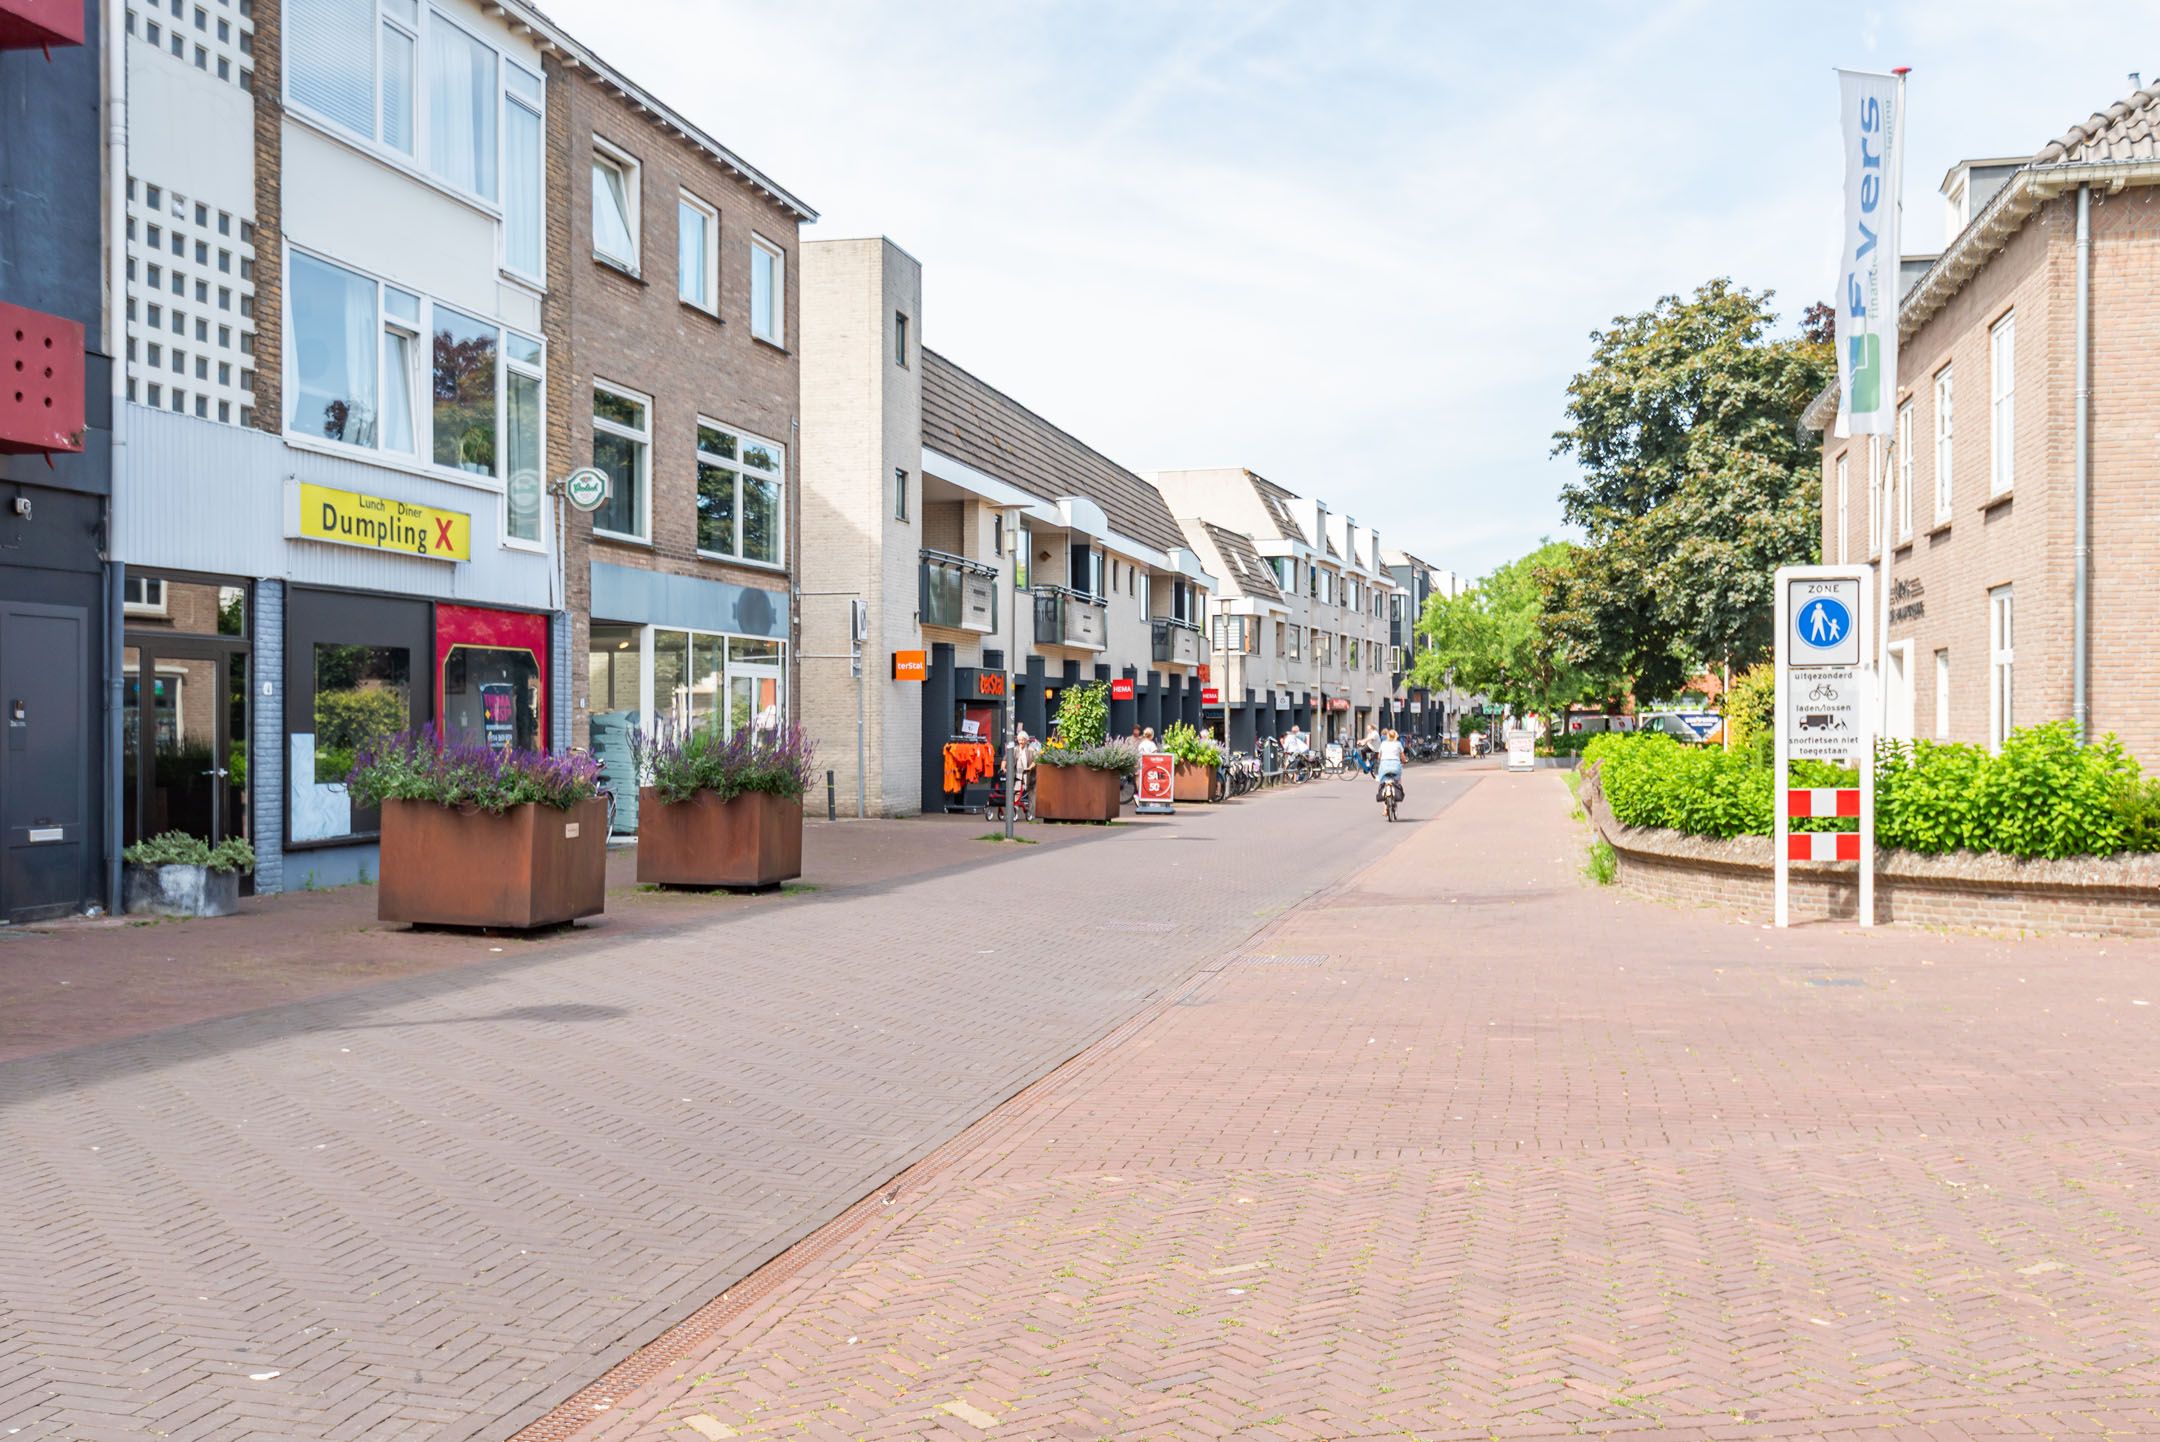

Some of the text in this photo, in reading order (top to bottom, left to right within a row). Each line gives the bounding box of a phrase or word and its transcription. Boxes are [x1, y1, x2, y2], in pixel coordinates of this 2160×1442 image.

[359, 495, 422, 518] Lunch Diner
[322, 502, 454, 554] Dumpling X
[1808, 584, 1840, 594] ZONE
[1794, 672, 1853, 681] uitgezonderd
[1796, 704, 1851, 712] laden/lossen
[1788, 736, 1839, 745] snorfietsen
[1799, 747, 1848, 756] toegestaan
